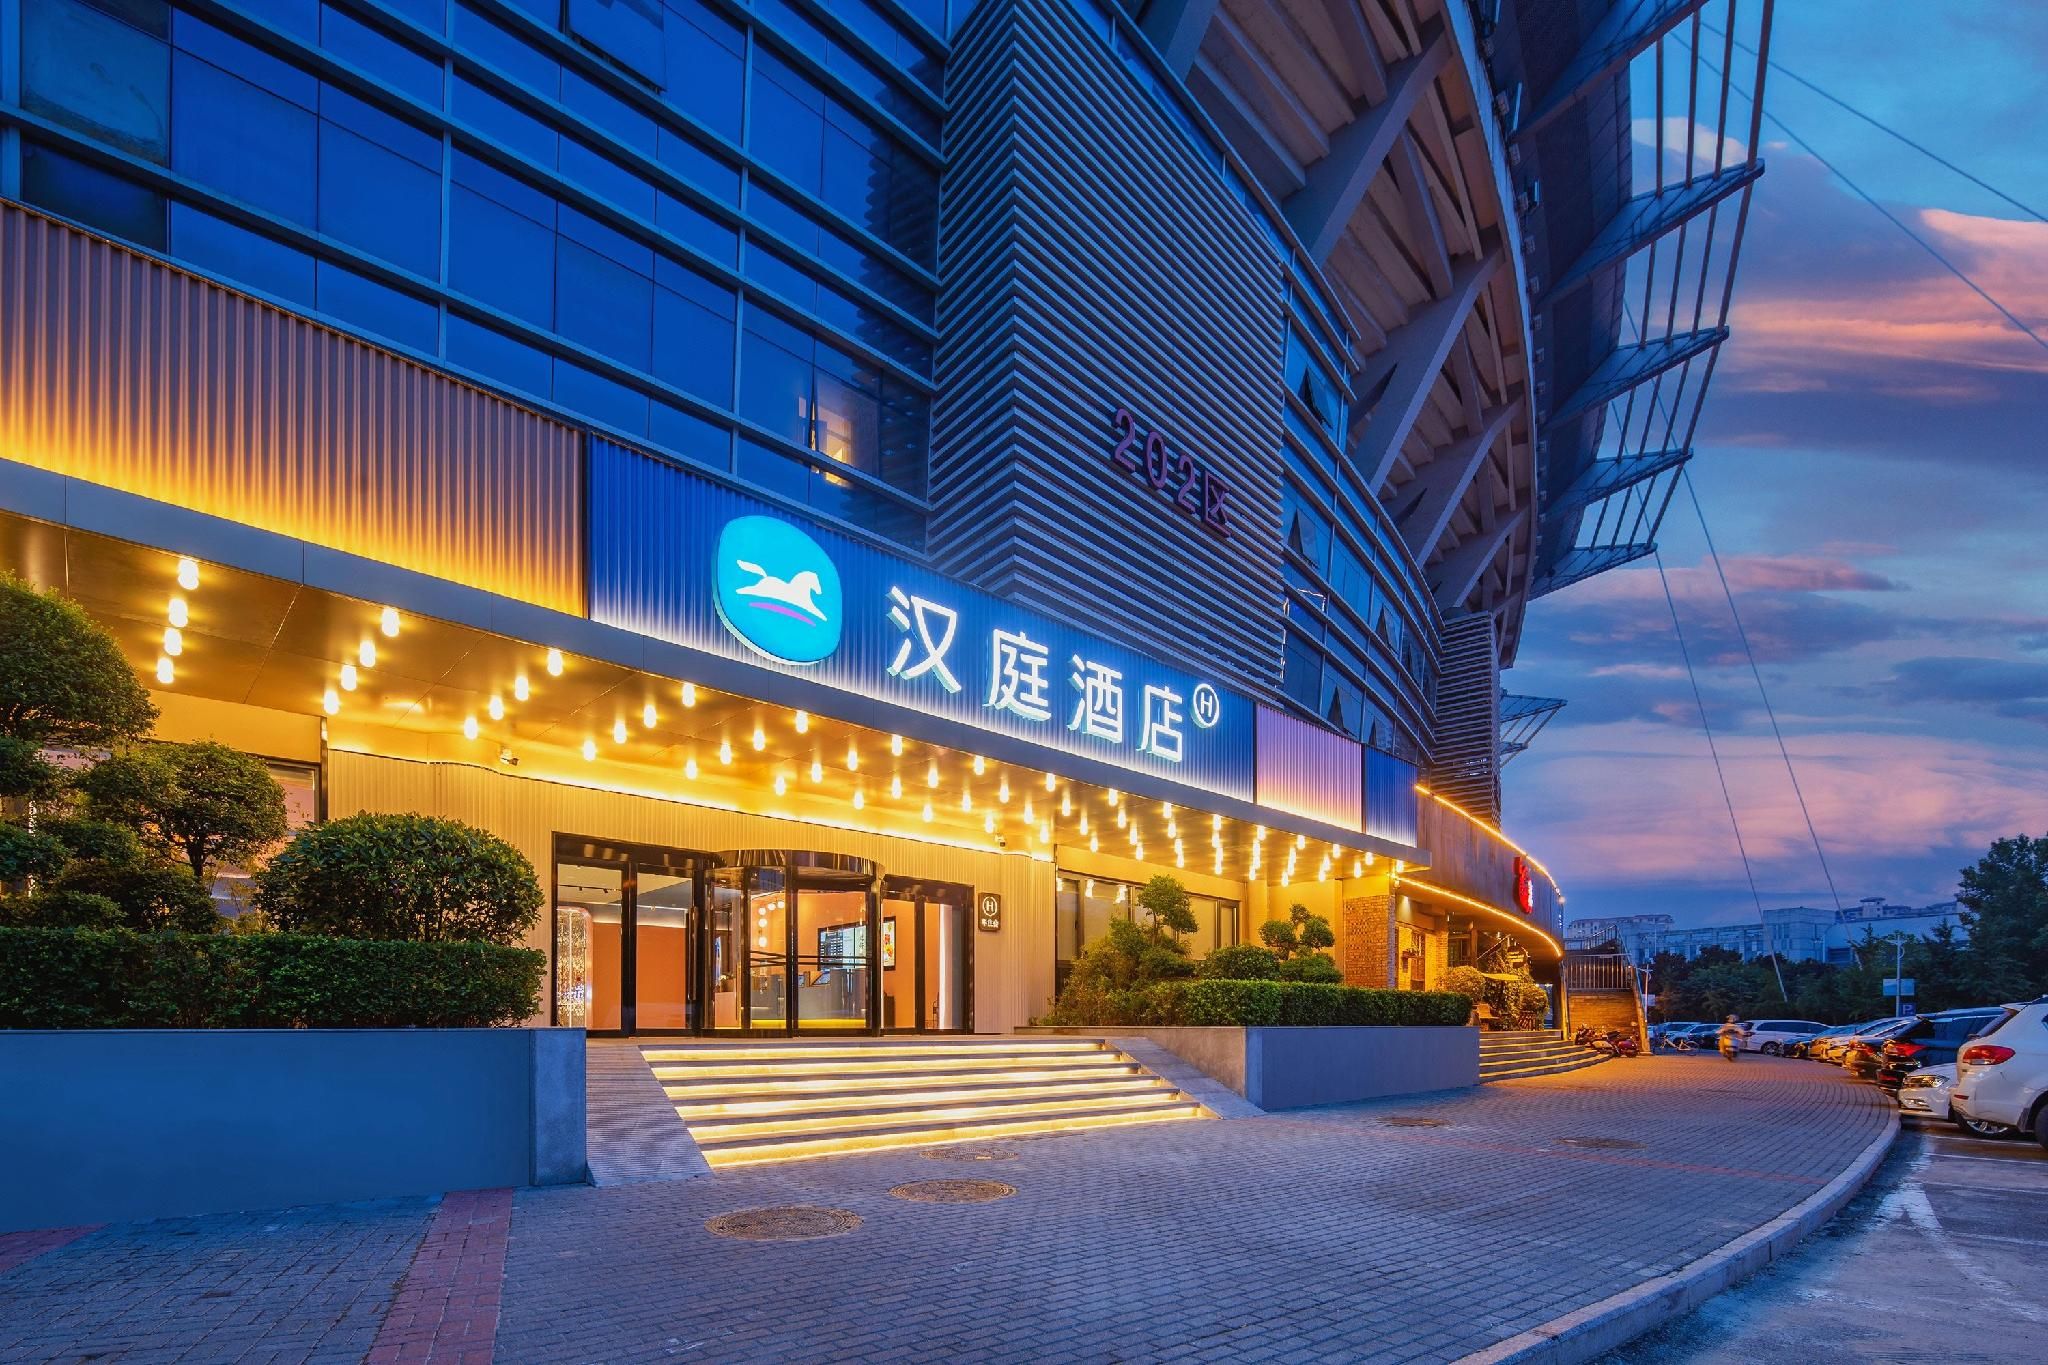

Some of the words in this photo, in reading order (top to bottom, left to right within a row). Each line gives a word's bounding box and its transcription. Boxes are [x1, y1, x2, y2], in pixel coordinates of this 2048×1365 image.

[1113, 408, 1233, 538] 202区
[886, 586, 1183, 762] 汉庭酒店
[1902, 1004, 1913, 1015] P
